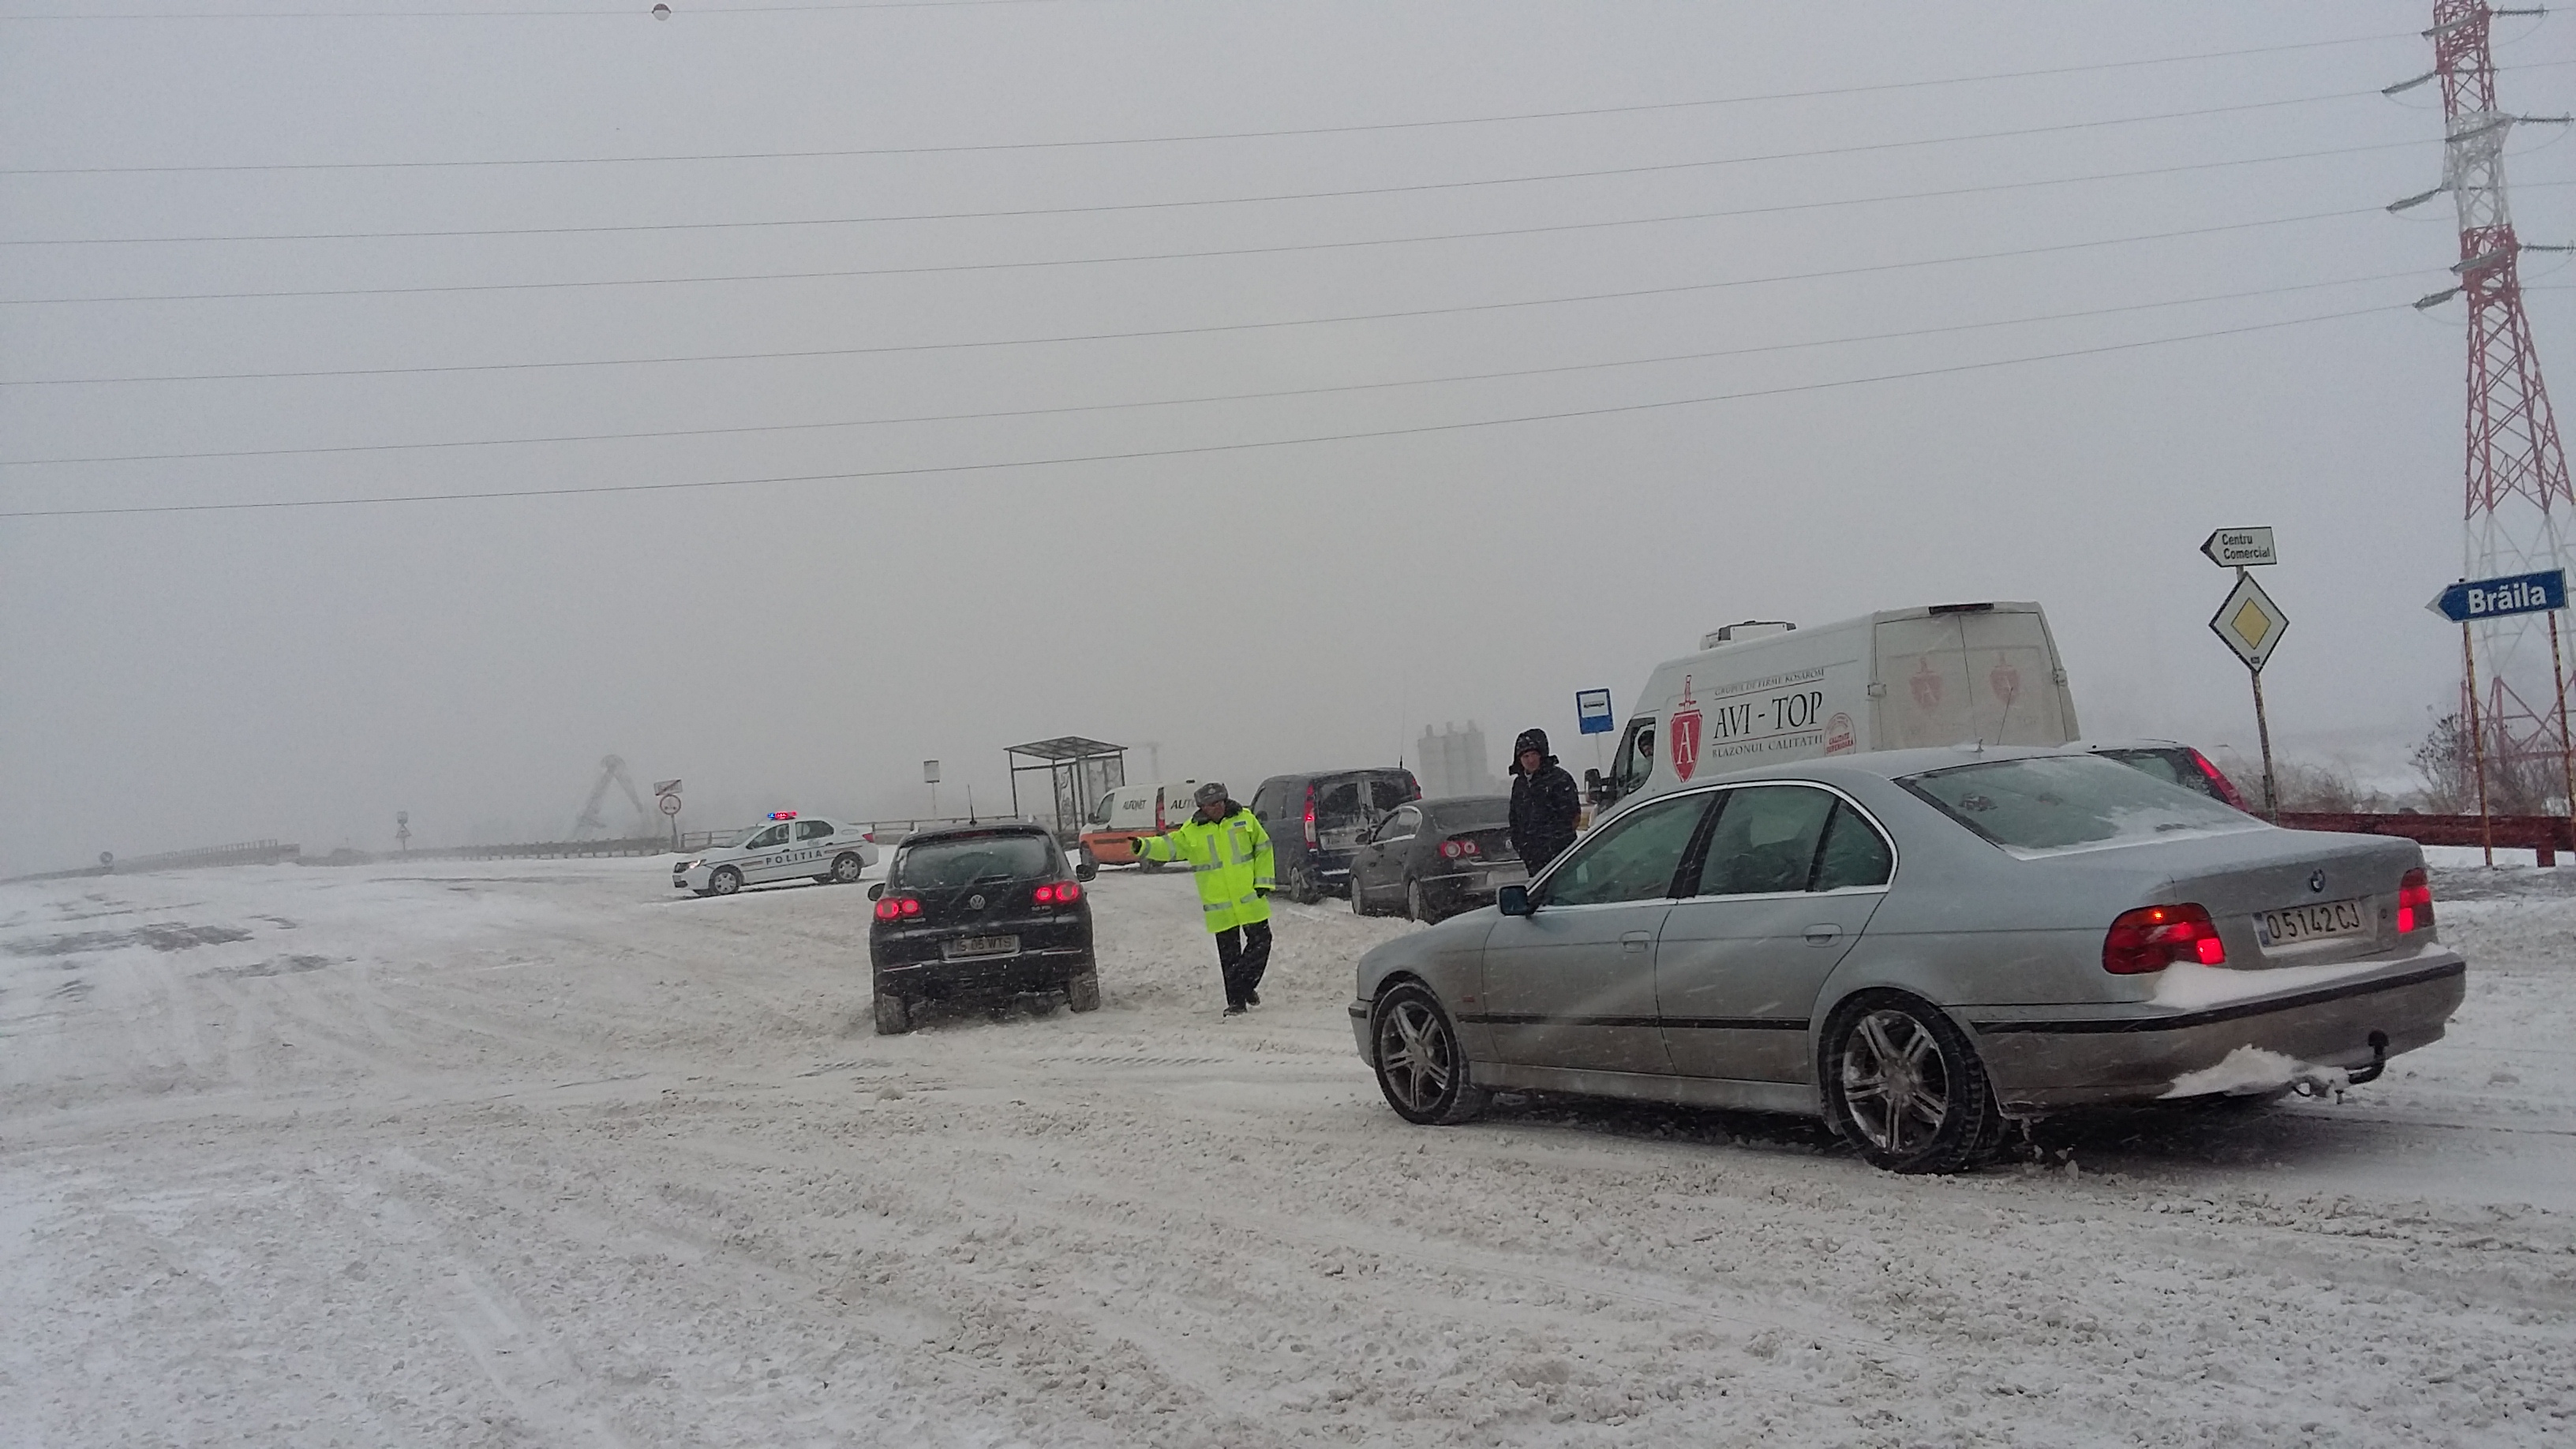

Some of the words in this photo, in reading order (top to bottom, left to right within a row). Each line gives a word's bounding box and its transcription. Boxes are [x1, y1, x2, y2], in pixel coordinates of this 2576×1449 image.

[2222, 534, 2253, 545] Centru
[2223, 546, 2271, 560] Comercial
[1713, 703, 1752, 739] AVI
[1772, 691, 1823, 730] TOP
[1676, 721, 1694, 764] A
[1713, 743, 1764, 758] BLAZONUL
[1769, 735, 1823, 751] CALITATII
[766, 850, 822, 866] POLITIA
